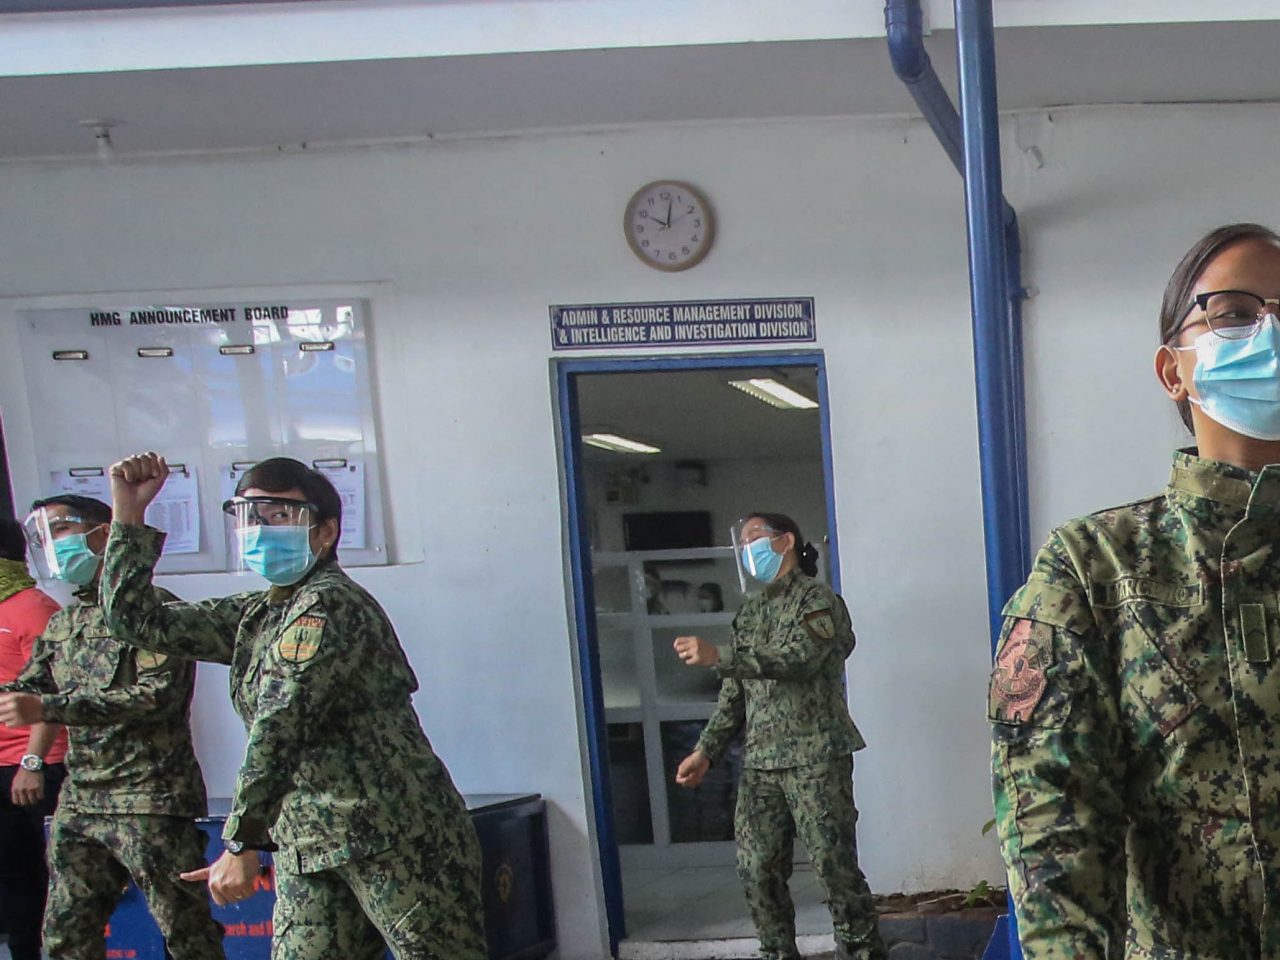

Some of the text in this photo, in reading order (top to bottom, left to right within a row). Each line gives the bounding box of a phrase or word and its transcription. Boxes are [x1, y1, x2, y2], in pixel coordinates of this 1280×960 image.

[687, 205, 695, 214] 2
[90, 306, 289, 327] HMG ANNOUNCEMENT BOARD
[562, 303, 803, 326] ADMIN & RESOURCE MANAGEMENT DIVISION
[560, 321, 808, 344] & INTELLIGENCE AND INVESTIGATION DIVISION
